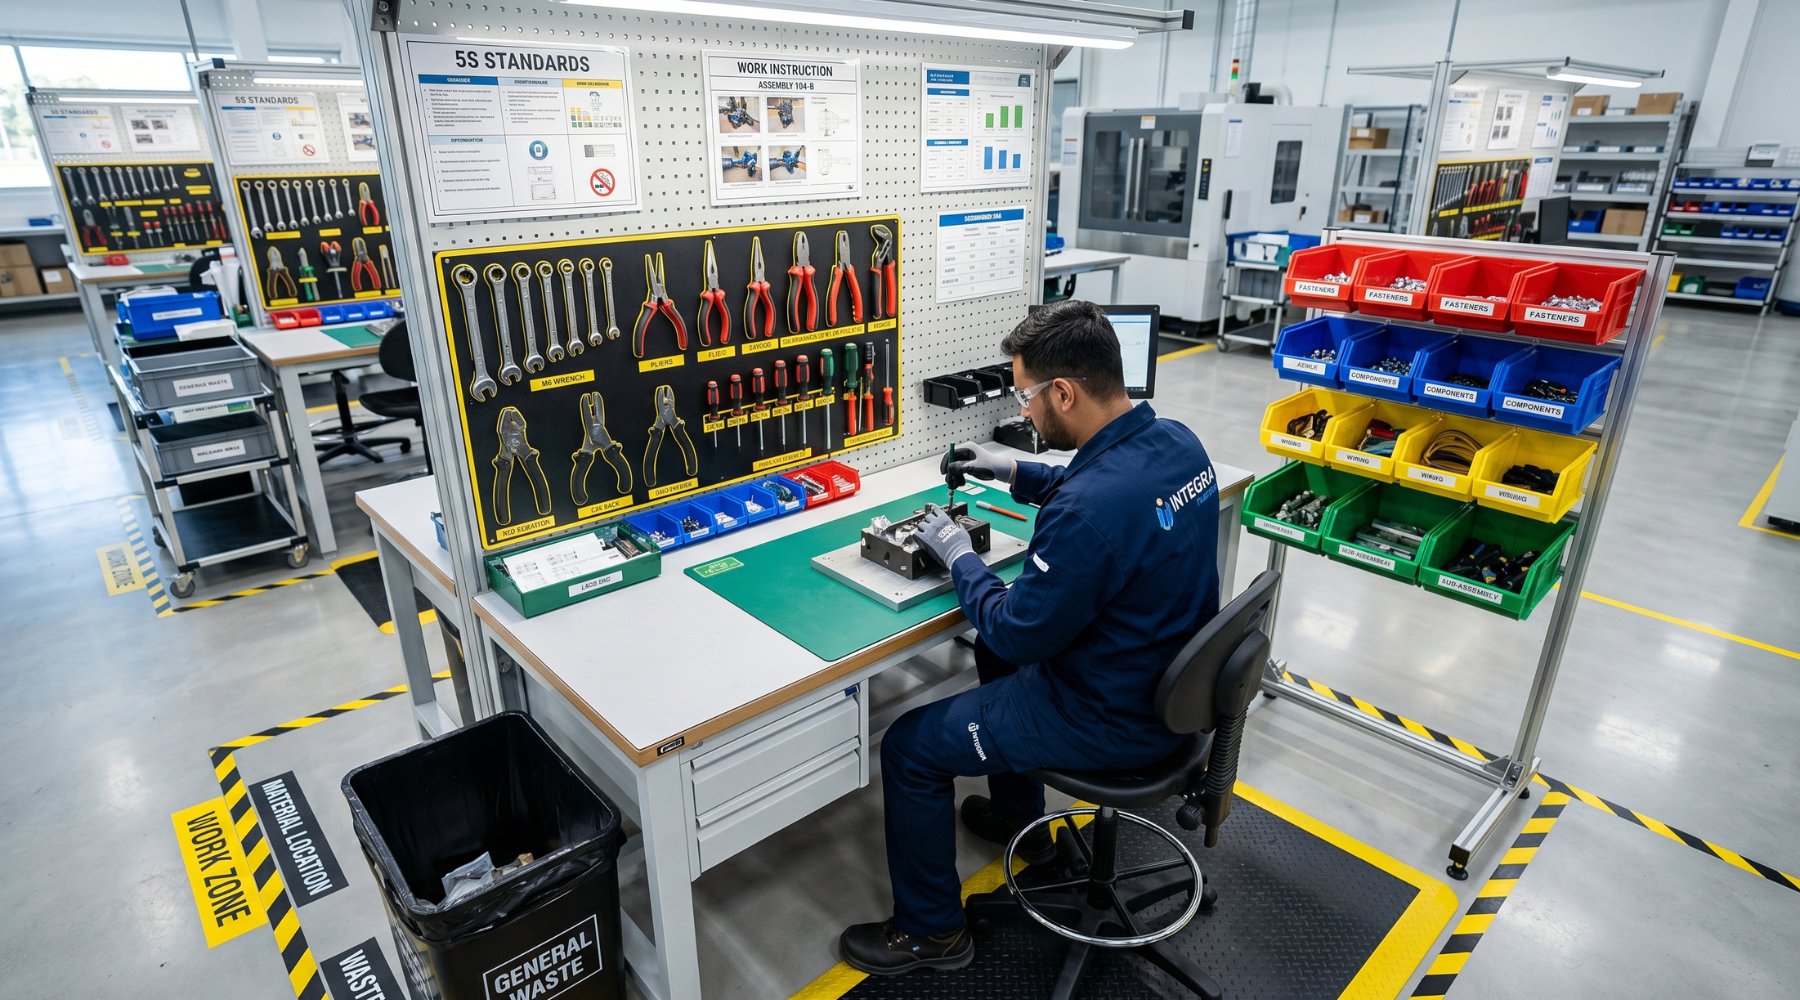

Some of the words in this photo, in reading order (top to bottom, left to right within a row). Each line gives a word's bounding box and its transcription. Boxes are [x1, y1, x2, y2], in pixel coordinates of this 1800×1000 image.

[455, 49, 479, 69] 5S
[484, 51, 590, 73] STANDARDS
[737, 61, 768, 75] WORK
[769, 64, 833, 77] INSTRUCTION
[758, 80, 794, 90] ASSEMBLY
[795, 82, 815, 91] 104-B
[235, 96, 247, 104] 5S
[248, 96, 300, 105] STANDARDS
[1298, 284, 1336, 294] FASTENERS
[1368, 291, 1409, 302] FASTENERS
[1444, 300, 1489, 313] FASTENERS
[1529, 311, 1580, 323] FASTENERS
[650, 358, 674, 368] PLIERS
[553, 373, 585, 385] WRENCH
[1426, 385, 1475, 400] COMPONENTS
[1505, 399, 1562, 416] COMPONENTS
[1169, 465, 1214, 512] INTEGRA
[186, 810, 233, 873] WORK
[261, 778, 304, 836] MATERIAL
[284, 830, 334, 896] LOCATION
[203, 866, 252, 929] ZONE
[494, 931, 593, 994] GENERAL
[509, 955, 584, 1000] WASTE
